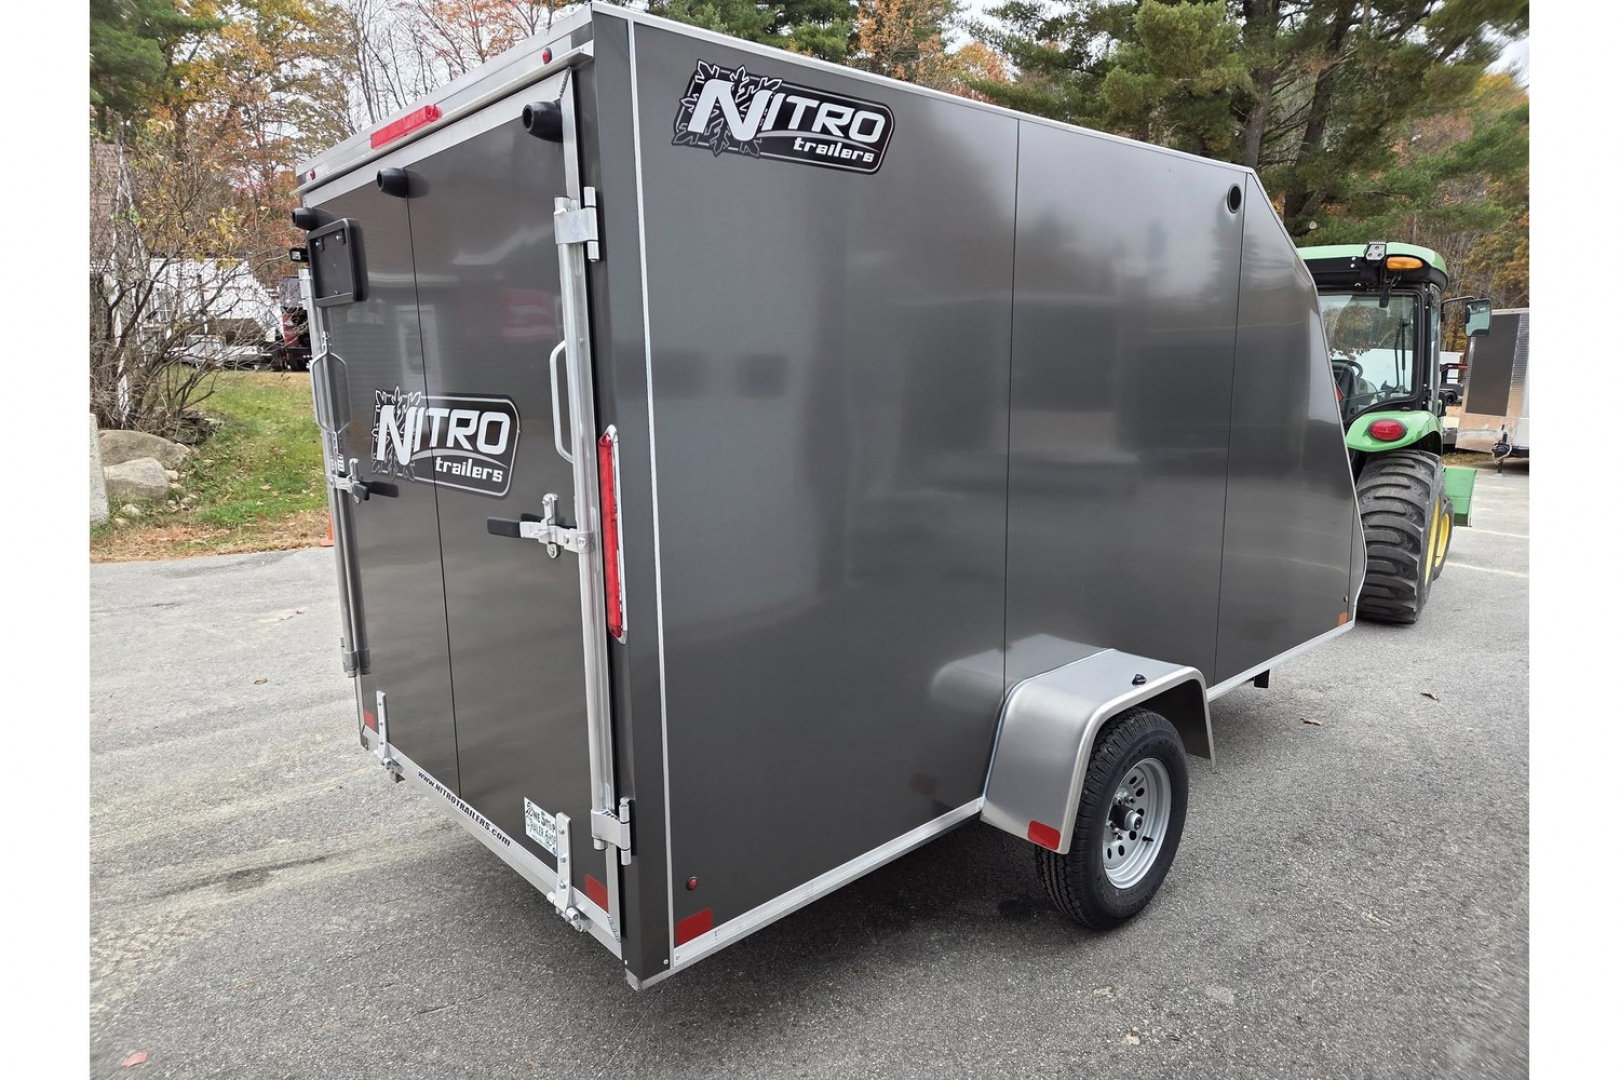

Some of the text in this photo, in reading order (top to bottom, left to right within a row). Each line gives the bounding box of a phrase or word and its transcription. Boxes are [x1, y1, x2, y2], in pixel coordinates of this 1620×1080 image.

[688, 79, 886, 143] NITRO
[793, 137, 875, 163] trailers
[376, 404, 511, 466] NITRO
[435, 457, 504, 483] trailers
